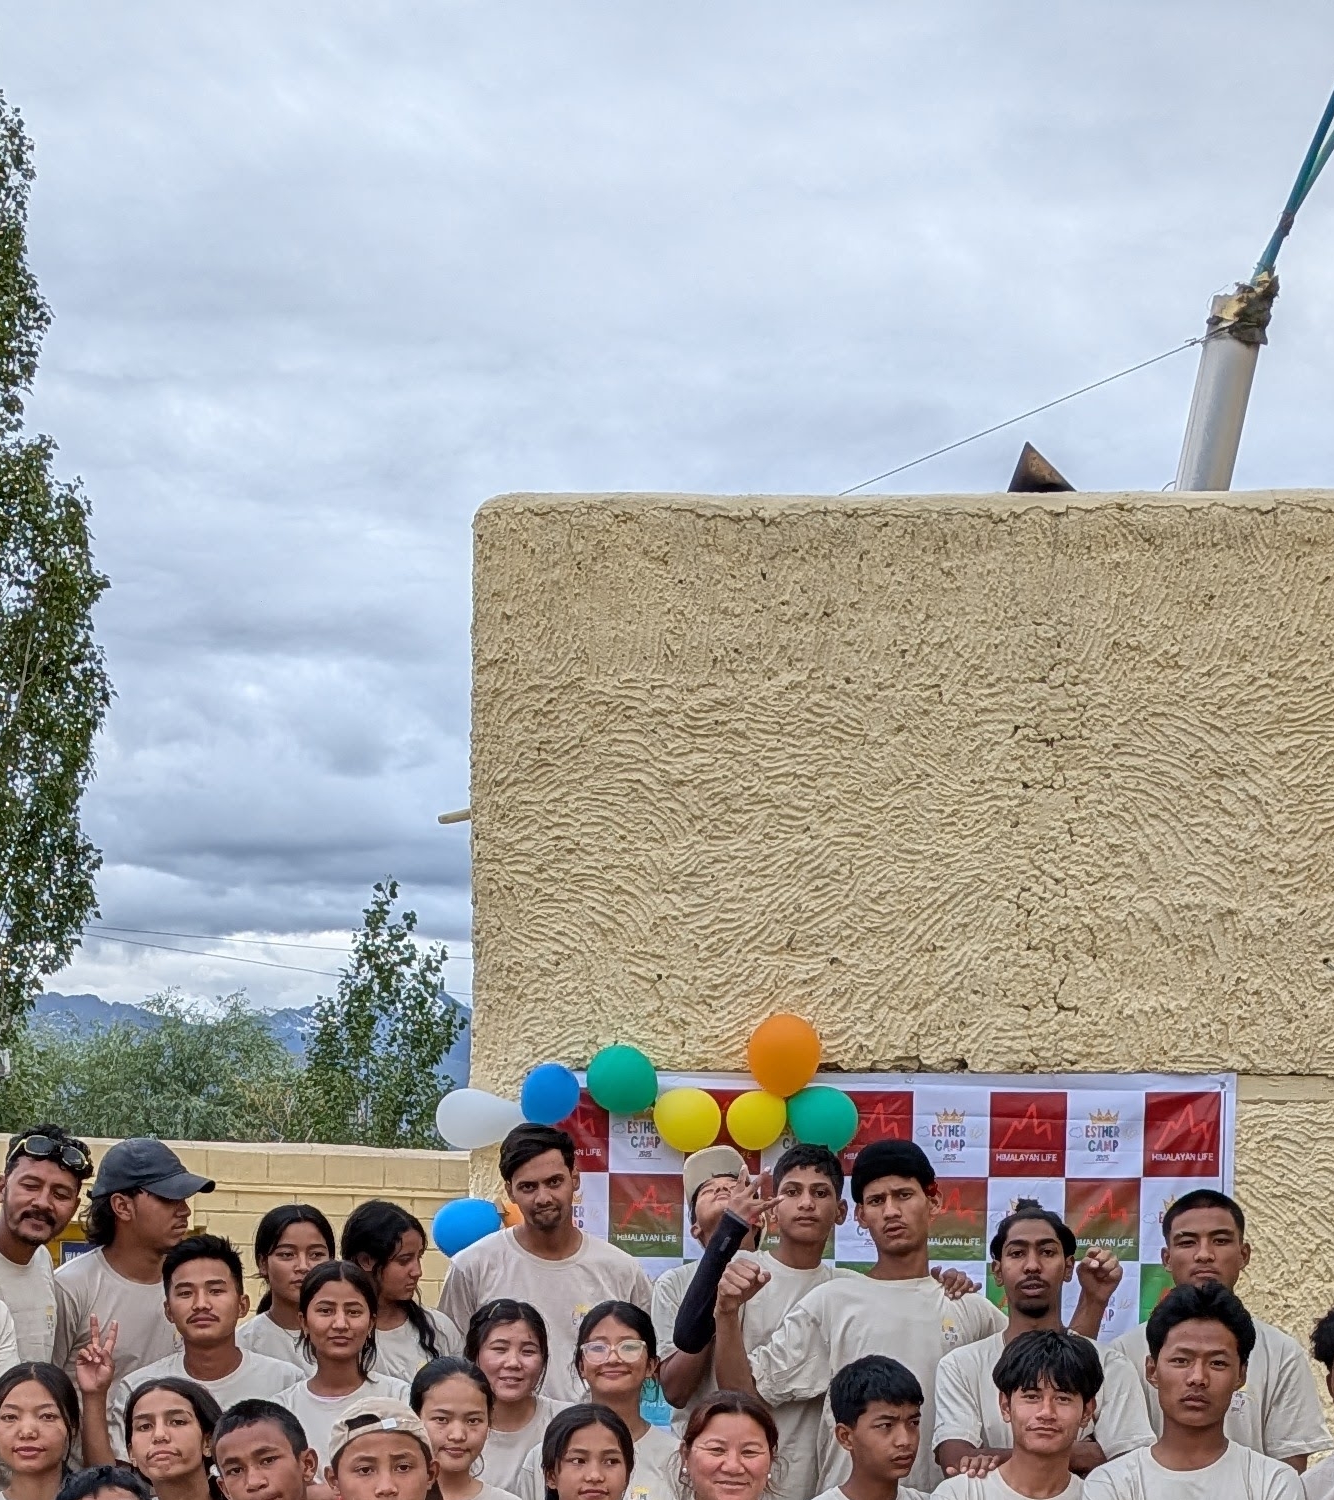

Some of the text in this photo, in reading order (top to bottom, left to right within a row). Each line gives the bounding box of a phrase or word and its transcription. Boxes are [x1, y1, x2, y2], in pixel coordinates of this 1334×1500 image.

[627, 1120, 657, 1134] ESTHE
[931, 1124, 967, 1138] ESTHER
[1085, 1125, 1120, 1138] ESTHER
[630, 1136, 661, 1149] CAMP
[935, 1139, 966, 1151] CAMP
[1088, 1140, 1119, 1152] CAMP
[996, 1153, 1057, 1162] HIMALAYAN LIFE
[1151, 1153, 1214, 1162] HIMALAYAN LIFE
[617, 1233, 677, 1243] HIMALAYAN LIFE
[927, 1237, 980, 1246] MALAYAN LIFE
[1117, 1238, 1134, 1247] LIFE
